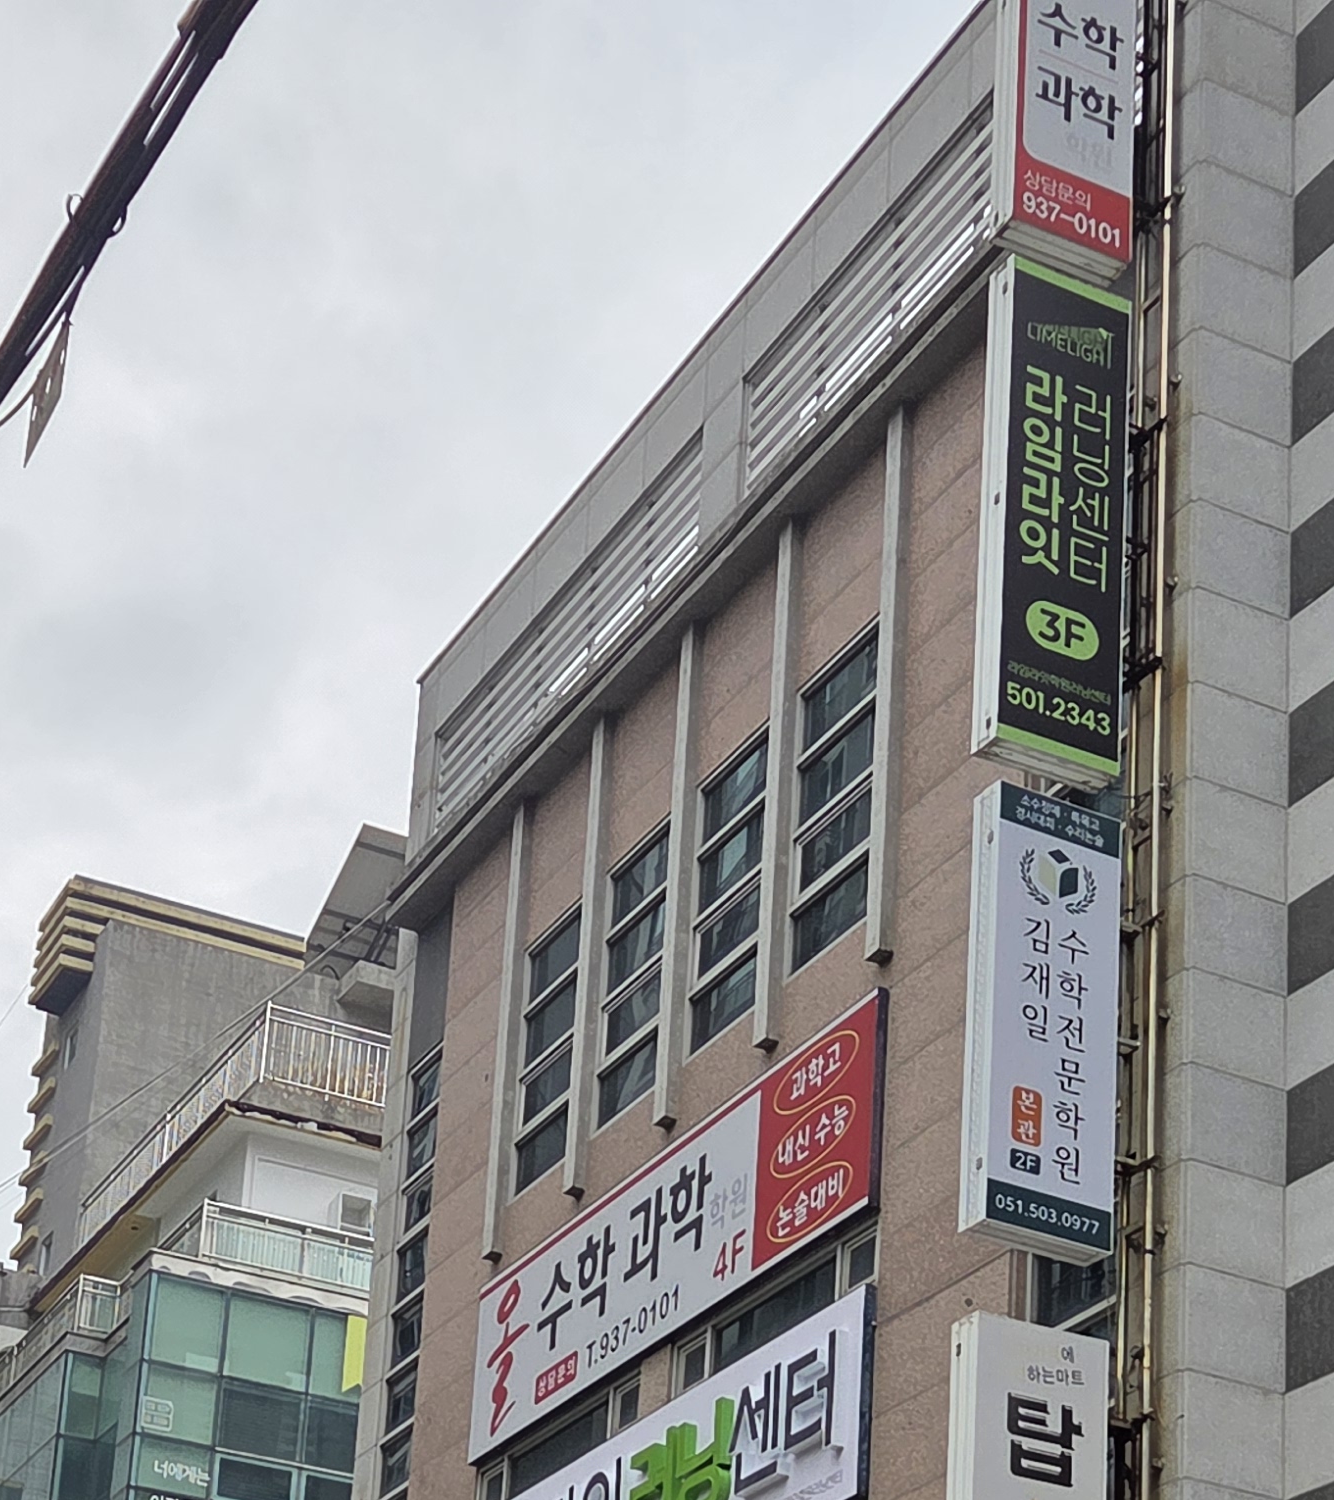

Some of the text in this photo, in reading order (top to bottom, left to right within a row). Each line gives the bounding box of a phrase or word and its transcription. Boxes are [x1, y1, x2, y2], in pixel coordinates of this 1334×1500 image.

[1037, 2, 1124, 71] 수학
[1036, 66, 1123, 140] 과학
[1022, 191, 1121, 248] 937-0101
[1023, 169, 1092, 211] 상담문의
[1019, 364, 1067, 575] 라임라잇
[1068, 384, 1111, 593] 러닝센터
[1037, 607, 1086, 650] 3F
[1006, 680, 1111, 737] 501.2343
[1021, 917, 1051, 1042] 김재일
[790, 1042, 842, 1100] 과학고
[1051, 929, 1090, 1185] 수학전문학원
[777, 1104, 849, 1167] 내신 수능
[1015, 1090, 1038, 1144] 본관
[1014, 1152, 1036, 1173] 2F
[776, 1169, 846, 1238] 논술대비
[995, 1193, 1100, 1236] 051.503.0977
[537, 1154, 749, 1351] 수학 과학 학원
[713, 1229, 746, 1281] 4F
[586, 1285, 681, 1370] T.937-0101
[1027, 1364, 1085, 1387] 하는마트
[1007, 1392, 1085, 1488] 탑
